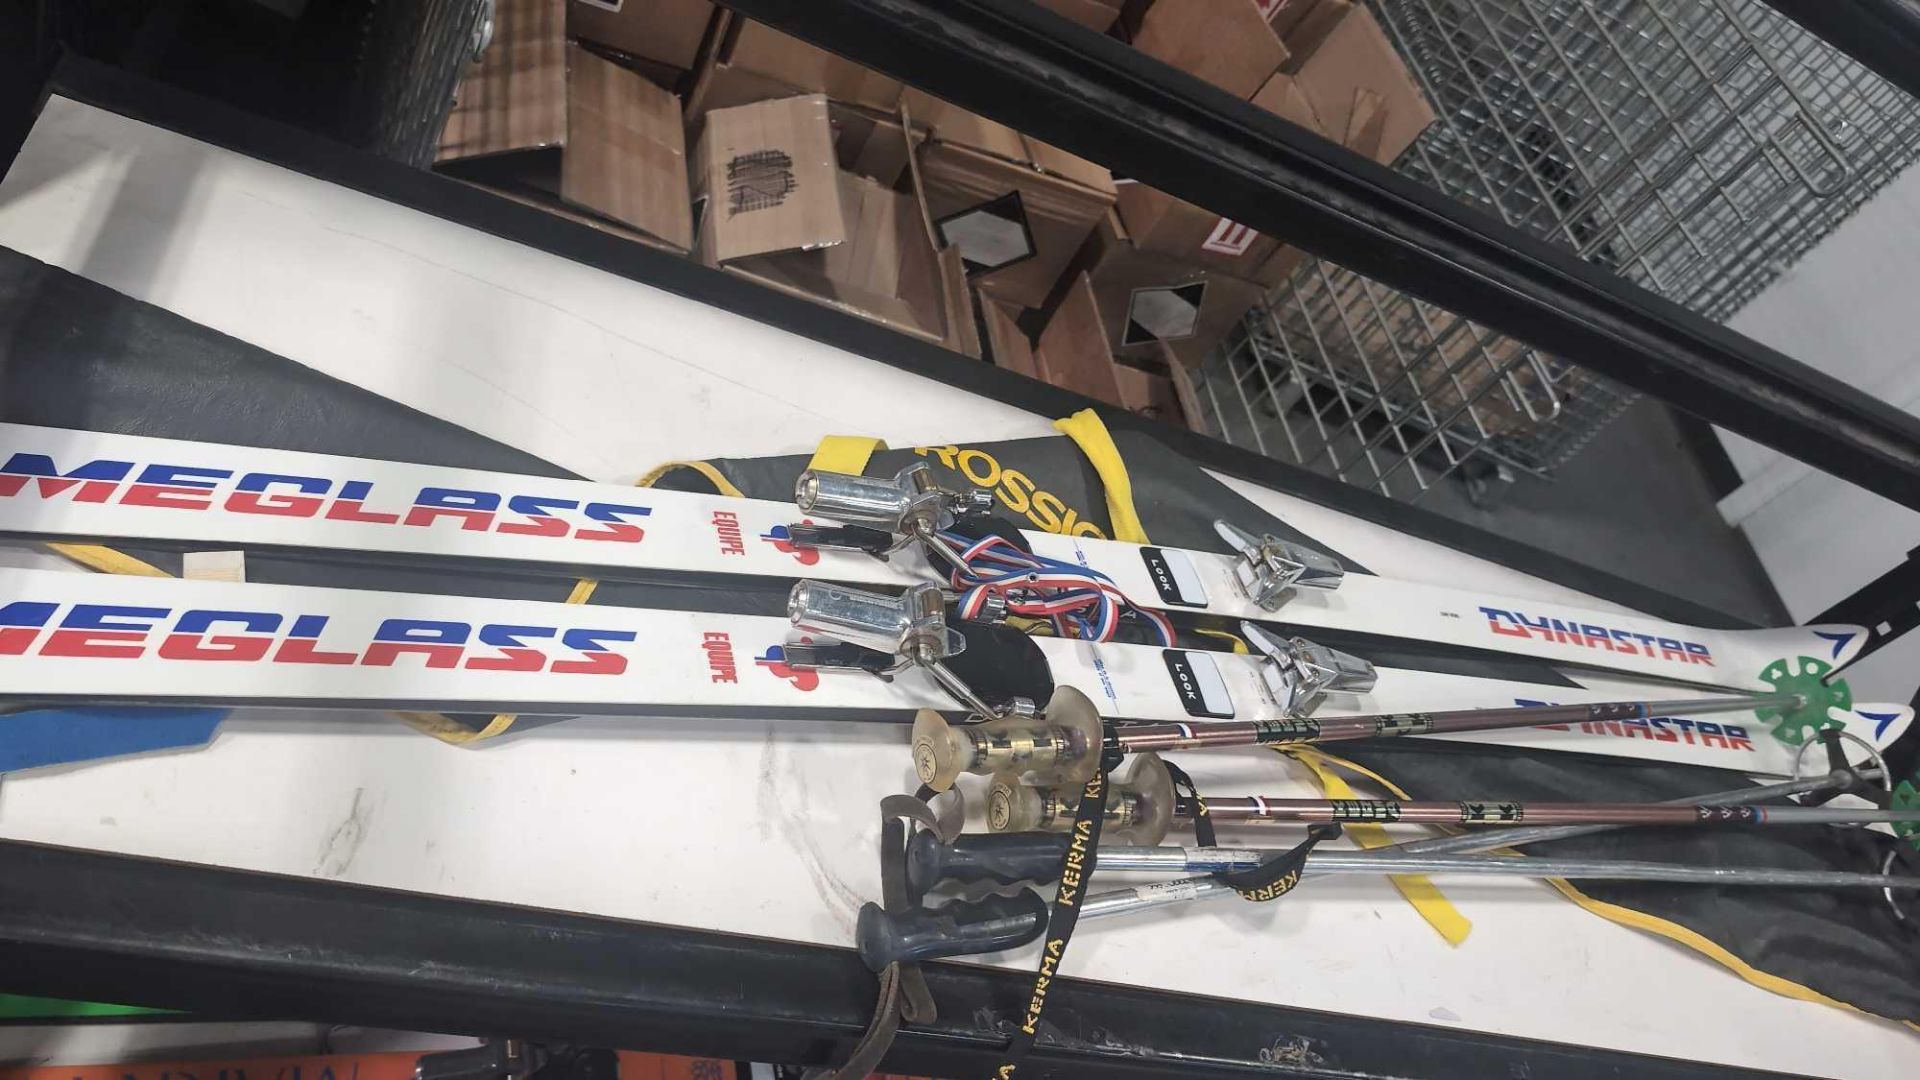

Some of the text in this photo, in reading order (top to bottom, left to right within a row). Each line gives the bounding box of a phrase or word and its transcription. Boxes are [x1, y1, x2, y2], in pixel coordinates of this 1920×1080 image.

[0, 452, 651, 543] MEGLASS
[713, 511, 745, 556] EQUIPE
[1151, 559, 1172, 591] LOOK
[701, 632, 738, 684] EQUIPE
[1478, 607, 1716, 667] DYNASTAR
[1175, 663, 1196, 700] LOOK
[1058, 819, 1092, 906] KERMA
[1022, 937, 1063, 1035] KERMA
